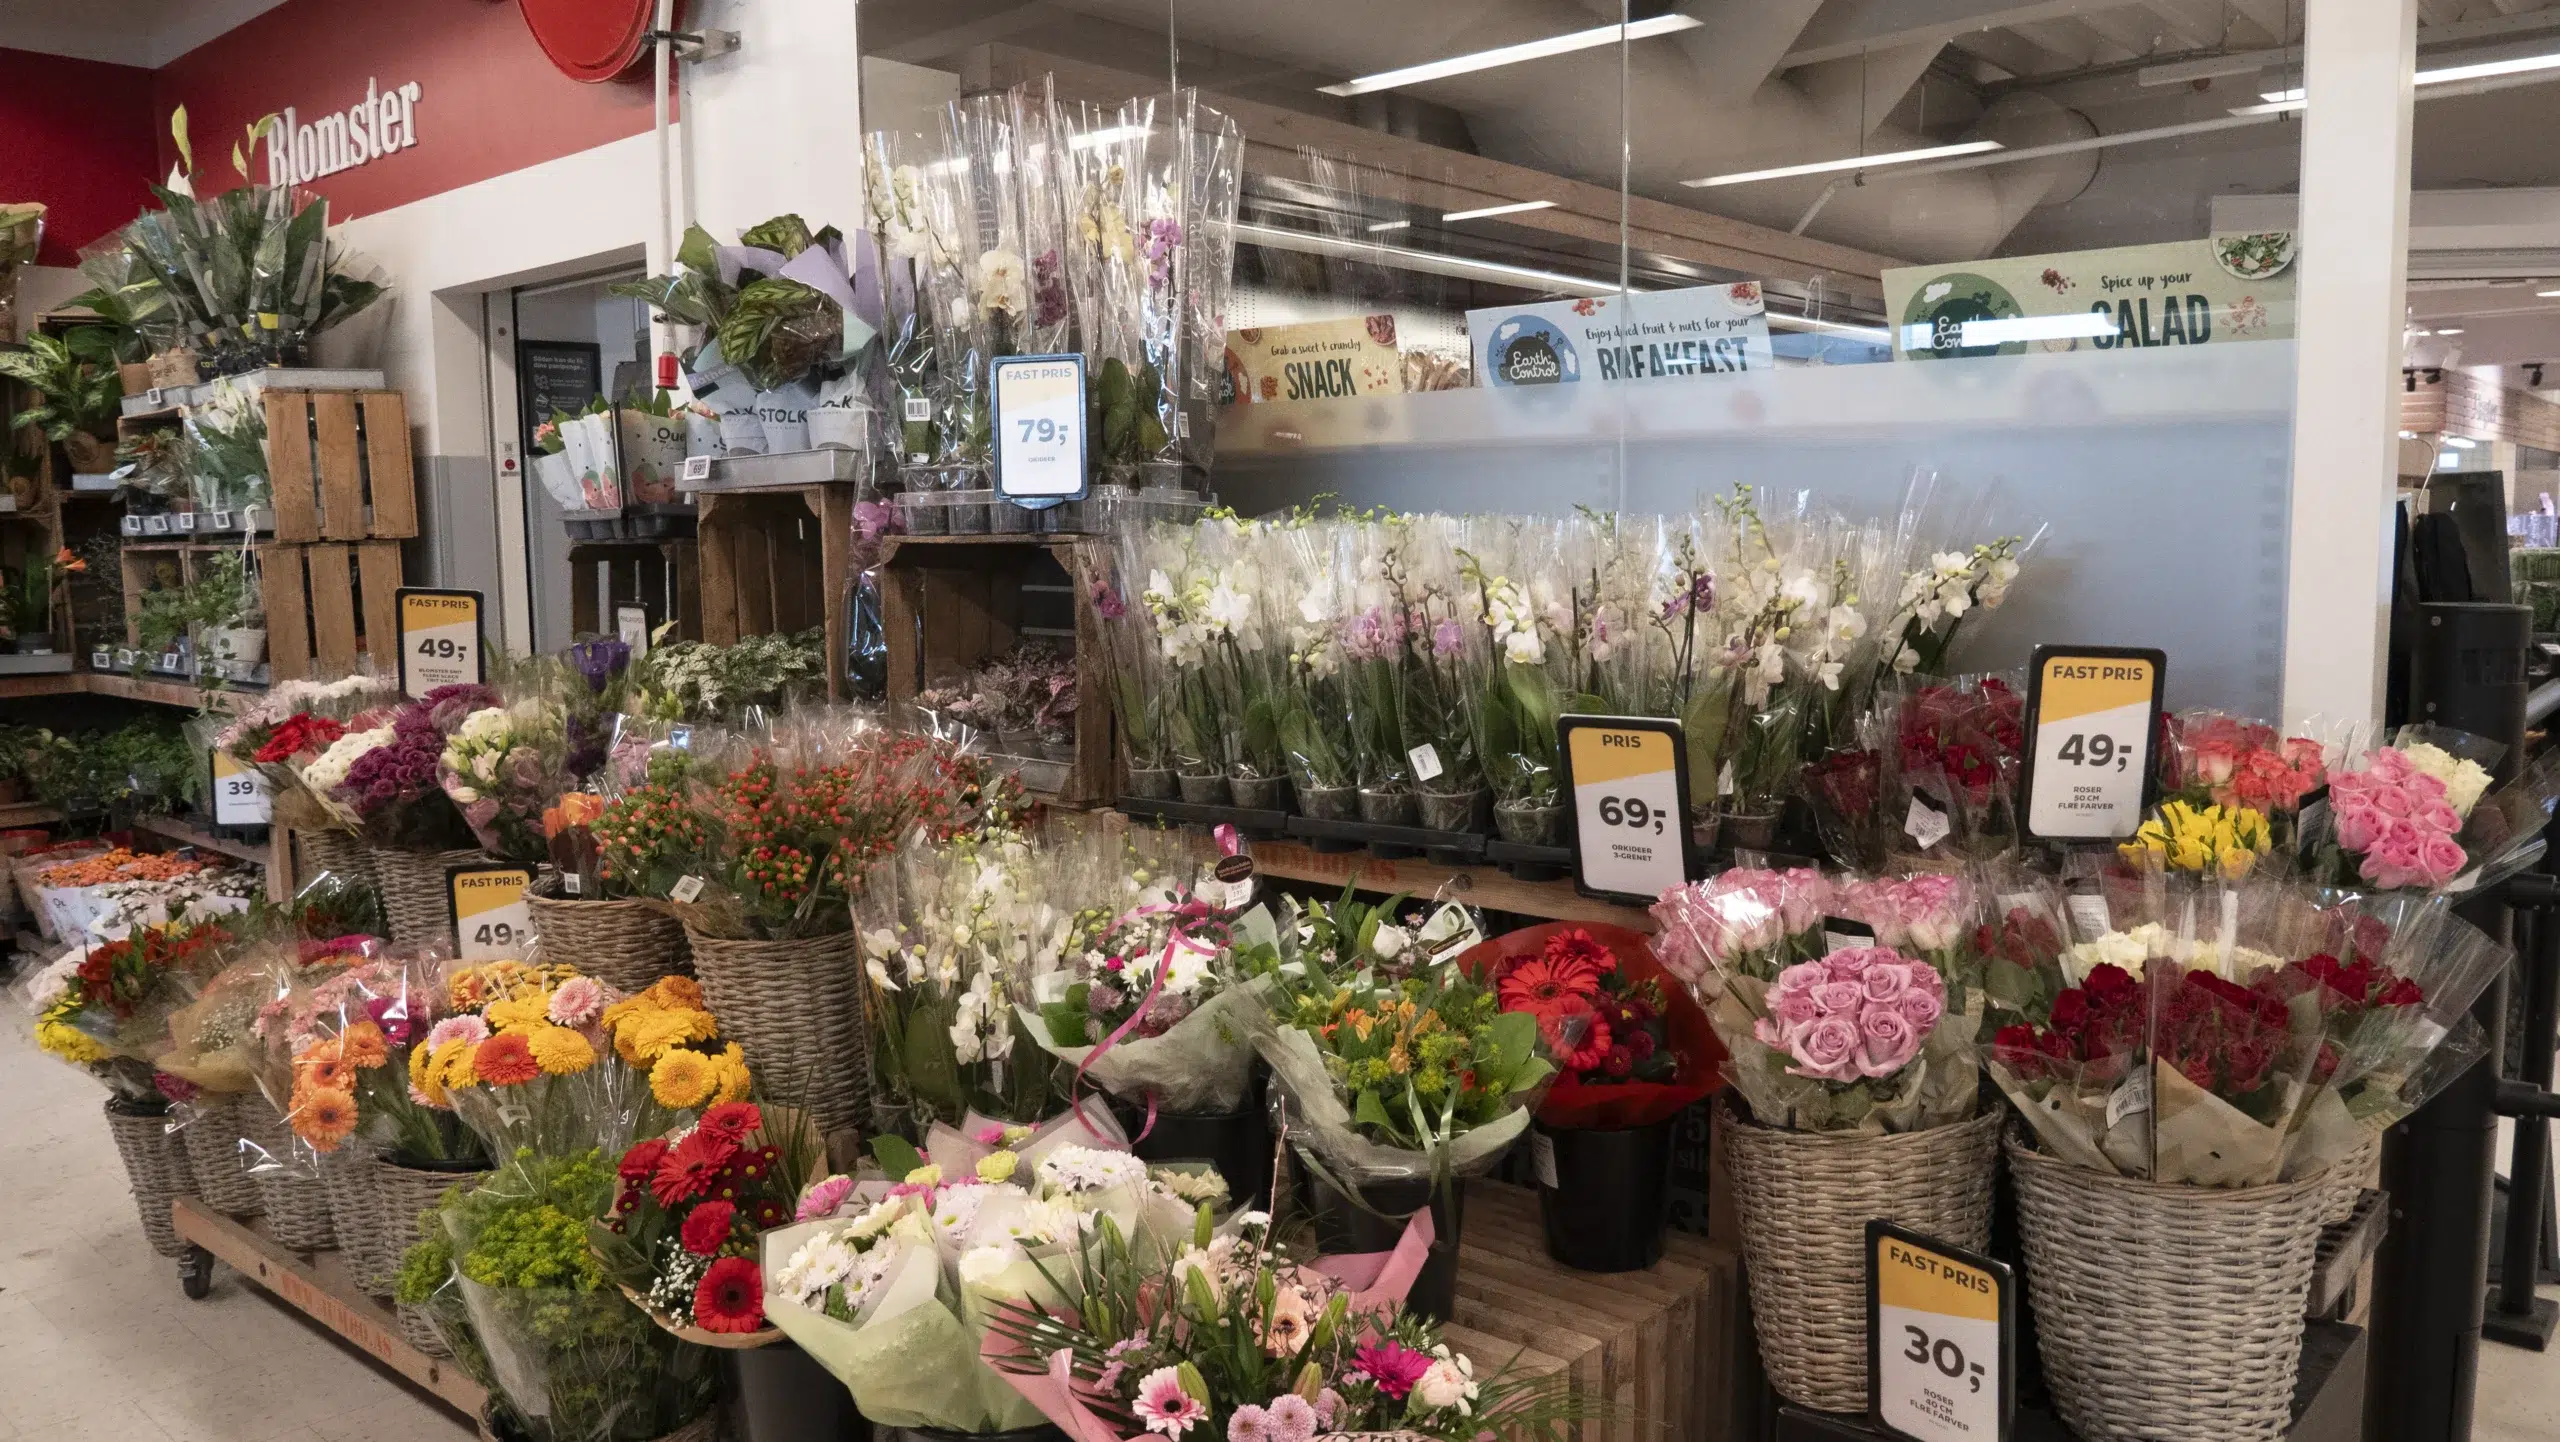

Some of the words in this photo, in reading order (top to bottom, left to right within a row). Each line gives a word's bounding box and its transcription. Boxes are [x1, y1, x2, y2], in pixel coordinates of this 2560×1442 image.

[267, 76, 421, 188] Blomster
[2101, 275, 2132, 292] Spice
[2138, 276, 2154, 290] up
[2160, 272, 2192, 289] your
[1585, 328, 1611, 344] Enjoy
[1642, 322, 1666, 335] fruit
[1679, 319, 1701, 332] nuts
[1705, 317, 1721, 330] for
[1725, 317, 1749, 332] your
[2091, 295, 2211, 349] SALAD
[1271, 345, 1289, 356] Grab
[1298, 343, 1319, 354] sweet
[1330, 338, 1361, 352] crunchy
[1513, 349, 1551, 367] Earth
[1006, 369, 1039, 380] FAST
[1042, 367, 1073, 379] PRIS
[1284, 358, 1357, 400] SNACK
[1510, 362, 1558, 379] Control
[759, 408, 807, 423] STOLK
[409, 598, 439, 608] FAST
[441, 600, 469, 609] PRIS
[2053, 665, 2098, 680] FAST
[2102, 666, 2143, 681] PRIS
[1602, 734, 1641, 748] PRIS
[2074, 786, 2102, 794] ROSER
[2080, 803, 2114, 811] FARVER
[1612, 844, 1652, 855] ORKIDEER
[1613, 852, 1652, 862] 3-GRENET
[461, 878, 492, 888] FAST
[494, 876, 523, 887] PRIS
[1890, 1246, 1939, 1275] FAST
[1943, 1266, 1989, 1294] PRIS
[1924, 1388, 1954, 1407] ROSER
[1925, 1398, 1938, 1410] 40
[1940, 1404, 1953, 1416] CM
[1910, 1399, 1932, 1415] FLRE
[1933, 1410, 1969, 1433] FARVER
